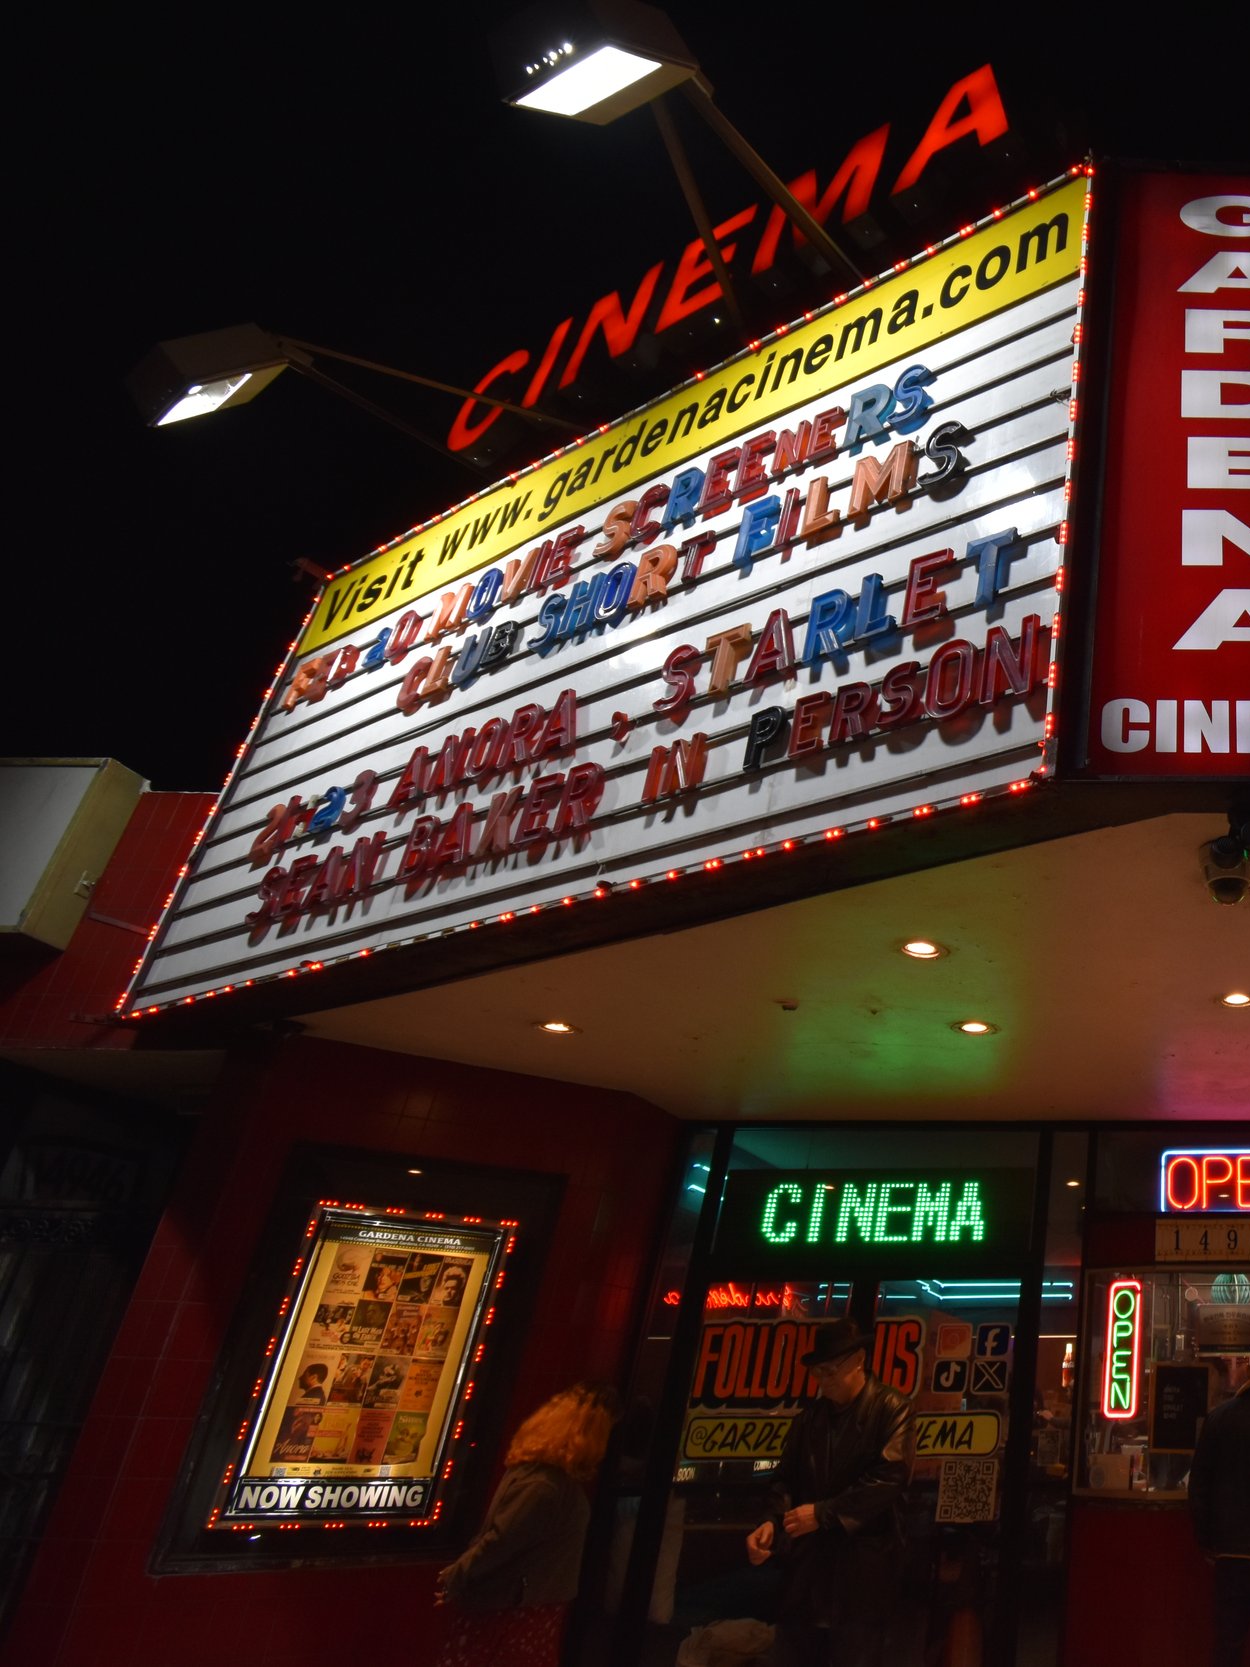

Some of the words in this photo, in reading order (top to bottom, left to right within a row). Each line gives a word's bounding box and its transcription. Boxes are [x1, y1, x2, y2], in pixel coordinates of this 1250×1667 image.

[447, 63, 1009, 451] CINEMA
[322, 549, 424, 631] Visit
[436, 212, 1069, 566] www.gardenacinema.com
[362, 609, 422, 671] 20
[424, 525, 585, 643] MOVIE
[594, 364, 934, 558] SCREENERS
[397, 620, 518, 713] CLUB
[528, 530, 718, 655] SHORT
[733, 420, 968, 566] FILMS
[652, 527, 1020, 712] STARLET
[245, 830, 387, 925] SEAN
[395, 761, 605, 882] BAKER
[641, 731, 709, 804] IN
[742, 613, 1042, 772] PERSON
[358, 1229, 414, 1243] GARDENA
[417, 1234, 462, 1246] CINEMA
[761, 1182, 985, 1242] CINEMA
[872, 1320, 922, 1399] US
[1110, 1289, 1136, 1410] OPEN
[238, 1486, 310, 1510] NOW
[305, 1485, 424, 1509] SHOWING
